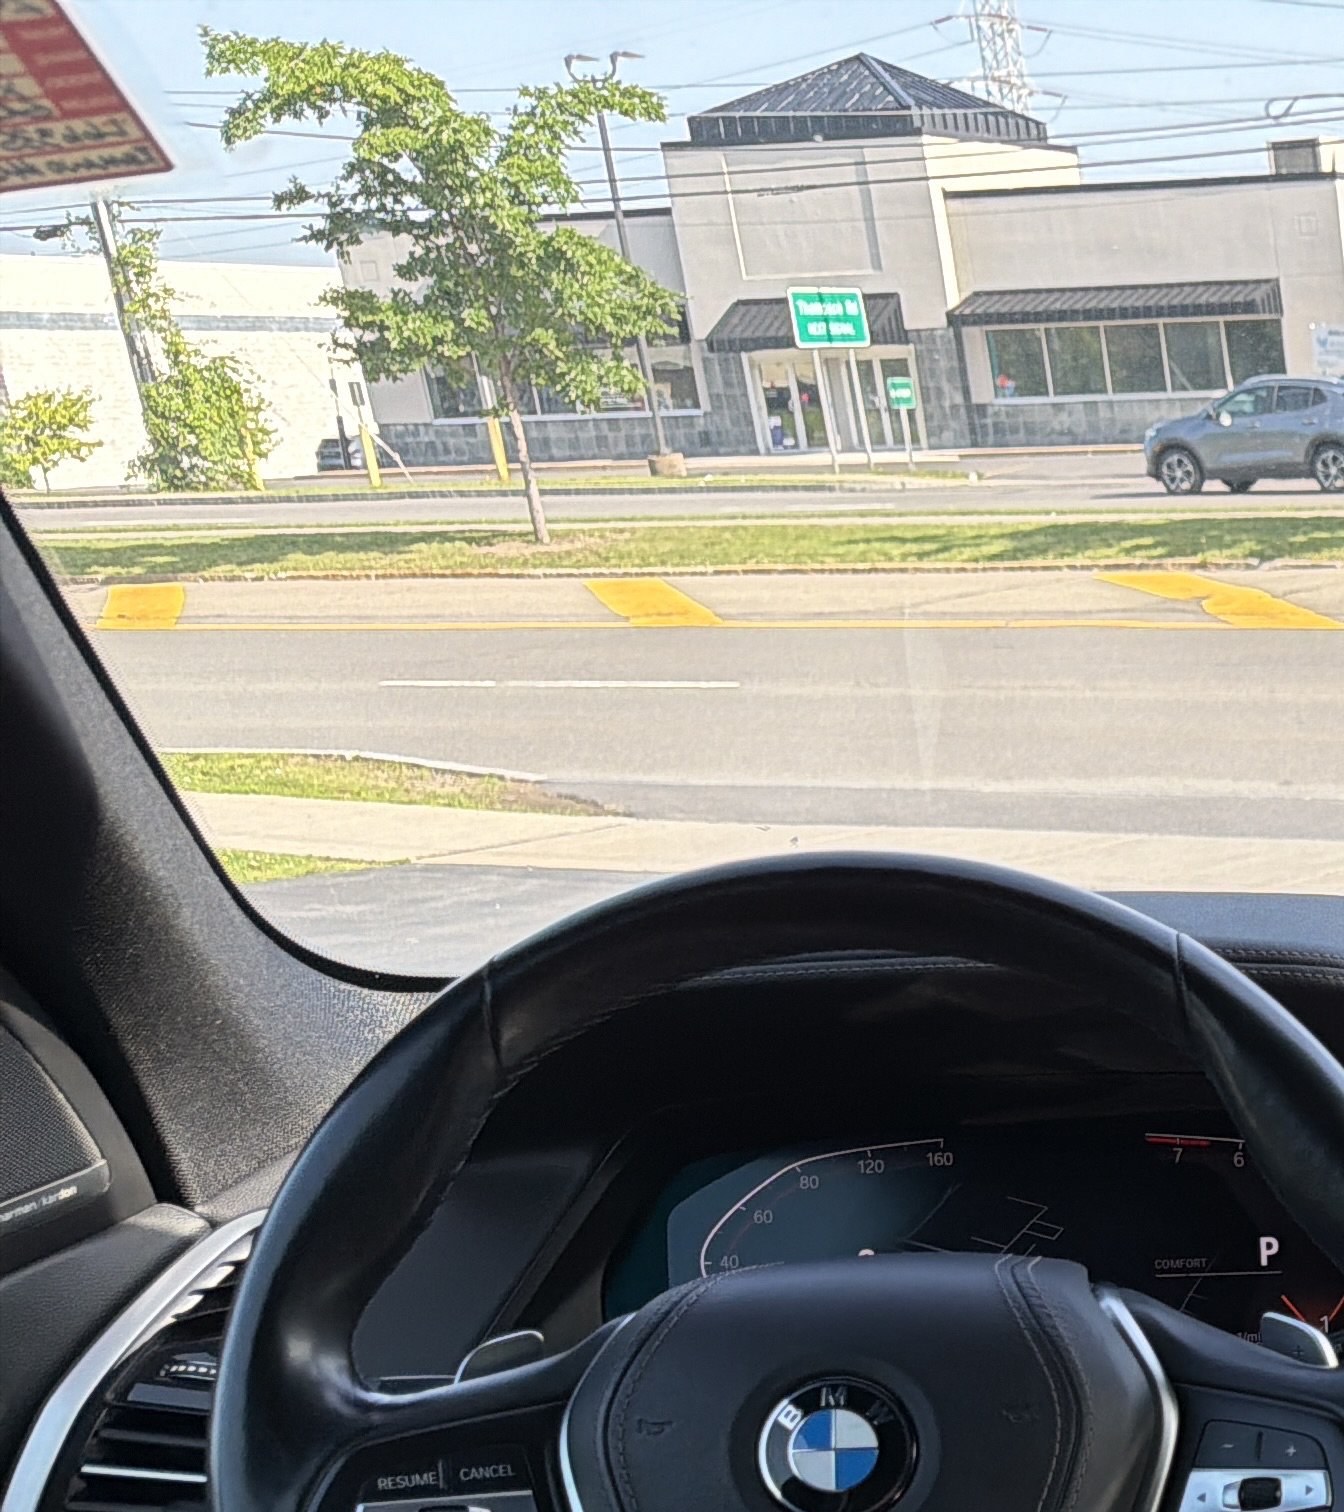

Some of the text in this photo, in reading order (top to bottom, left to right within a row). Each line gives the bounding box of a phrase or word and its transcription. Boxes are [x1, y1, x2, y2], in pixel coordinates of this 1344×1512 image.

[926, 1151, 953, 1166] 160
[1172, 1147, 1183, 1164] 7
[1232, 1151, 1245, 1168] 6
[857, 1159, 885, 1174] 120
[799, 1175, 819, 1190] 80
[753, 1210, 773, 1224] 60
[1259, 1236, 1279, 1267] P
[719, 1255, 739, 1269] 40
[1154, 1257, 1208, 1270] COMFORT
[777, 1386, 895, 1431] BMW
[377, 1471, 439, 1490] RESUME
[459, 1464, 516, 1481] CANCEL
